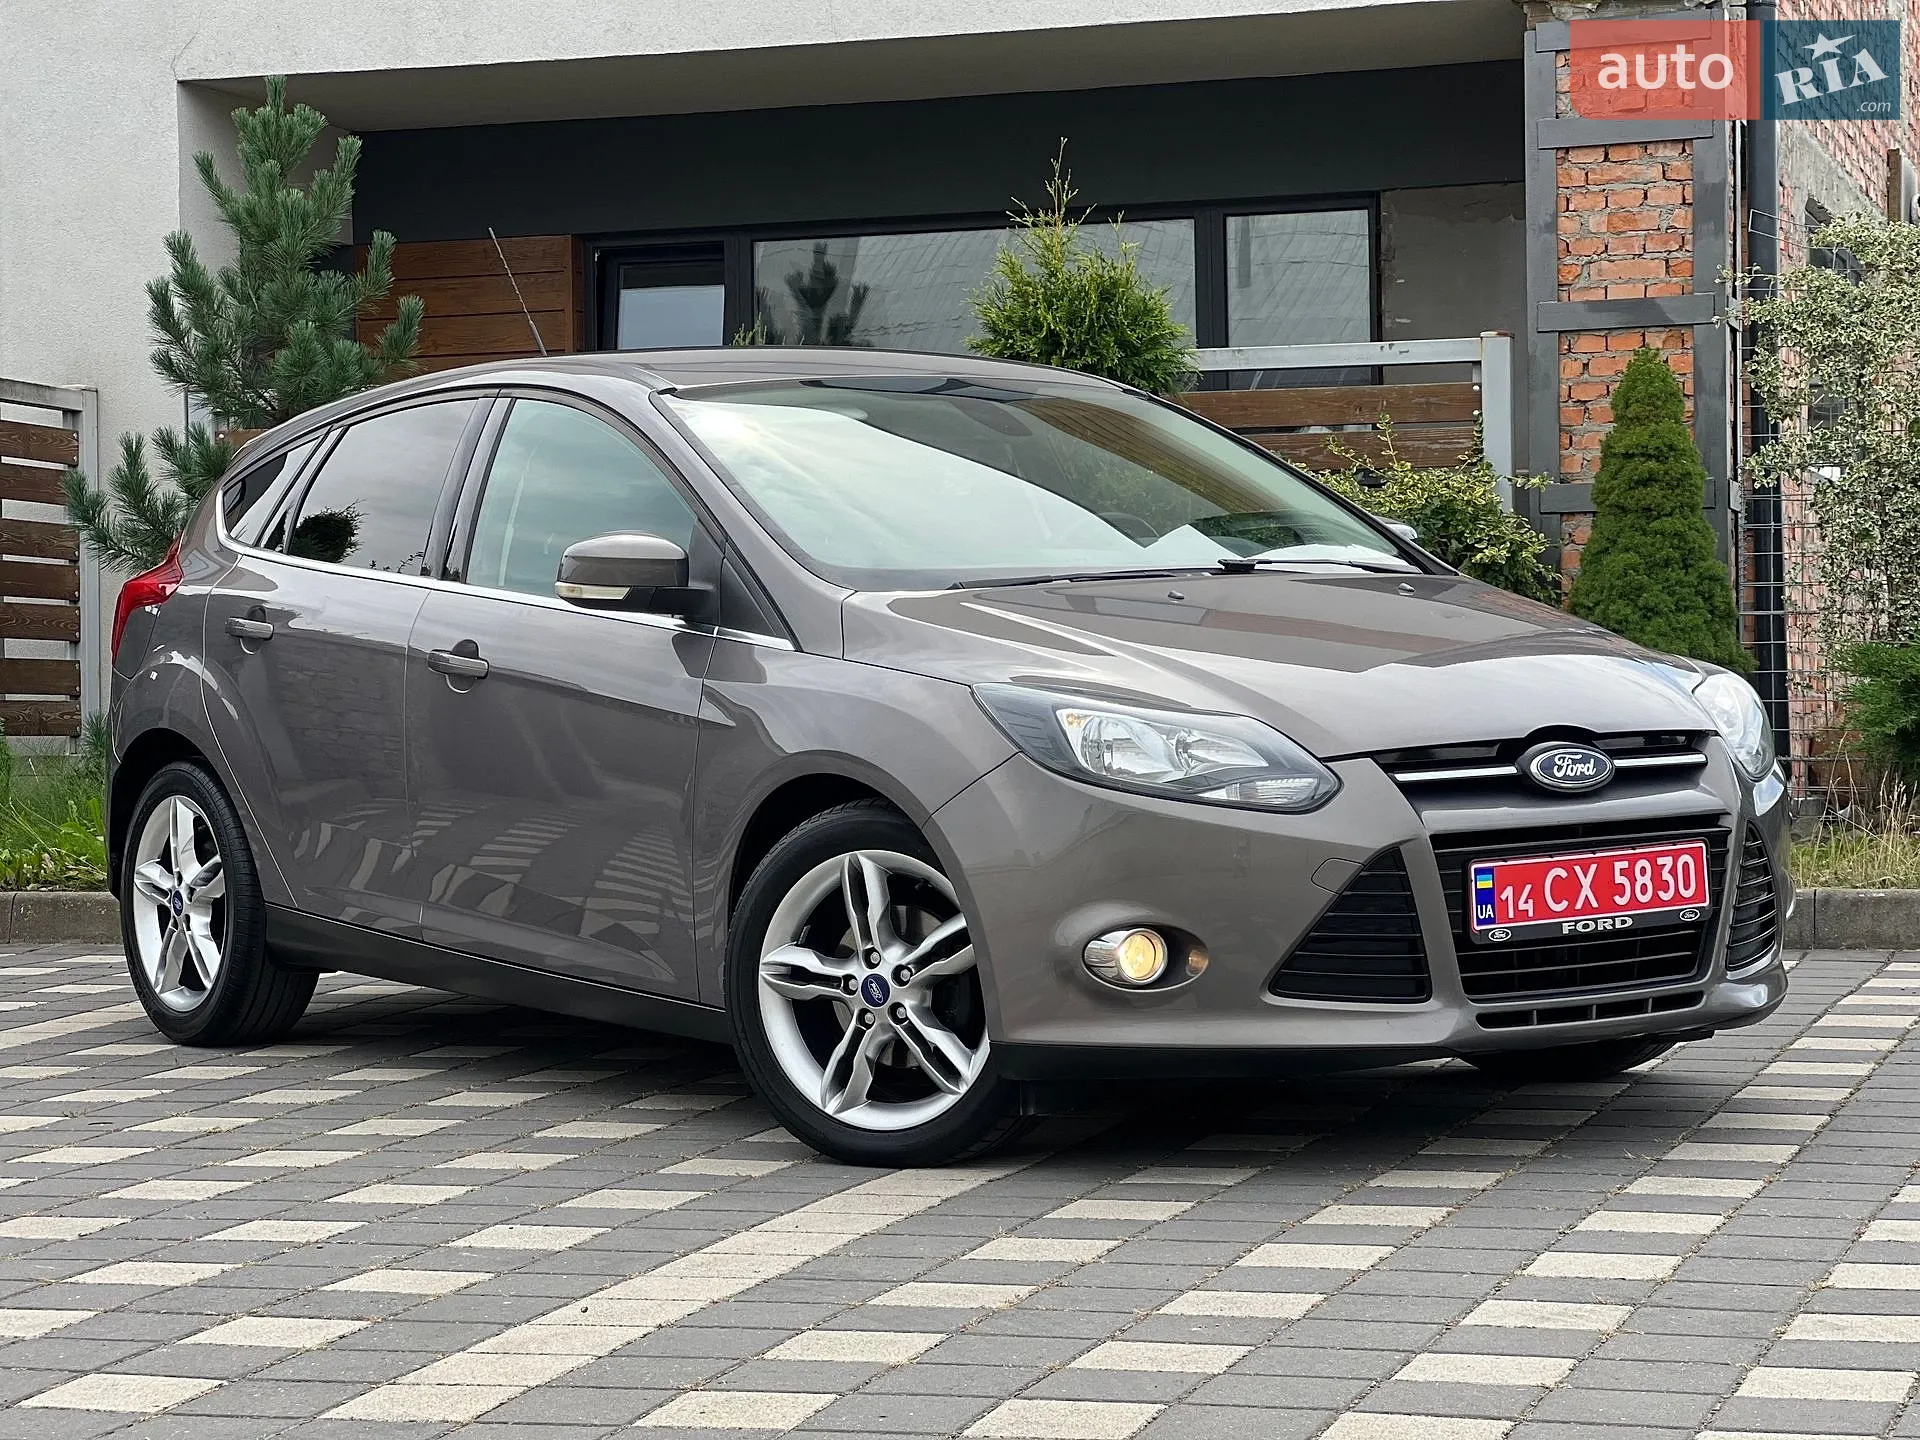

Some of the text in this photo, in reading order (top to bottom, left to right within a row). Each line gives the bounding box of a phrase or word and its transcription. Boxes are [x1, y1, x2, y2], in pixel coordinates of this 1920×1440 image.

[1553, 754, 1597, 778] Ford
[1499, 853, 1697, 919] 14 CX 5830
[1478, 904, 1494, 919] UA
[1562, 916, 1633, 934] FORD
